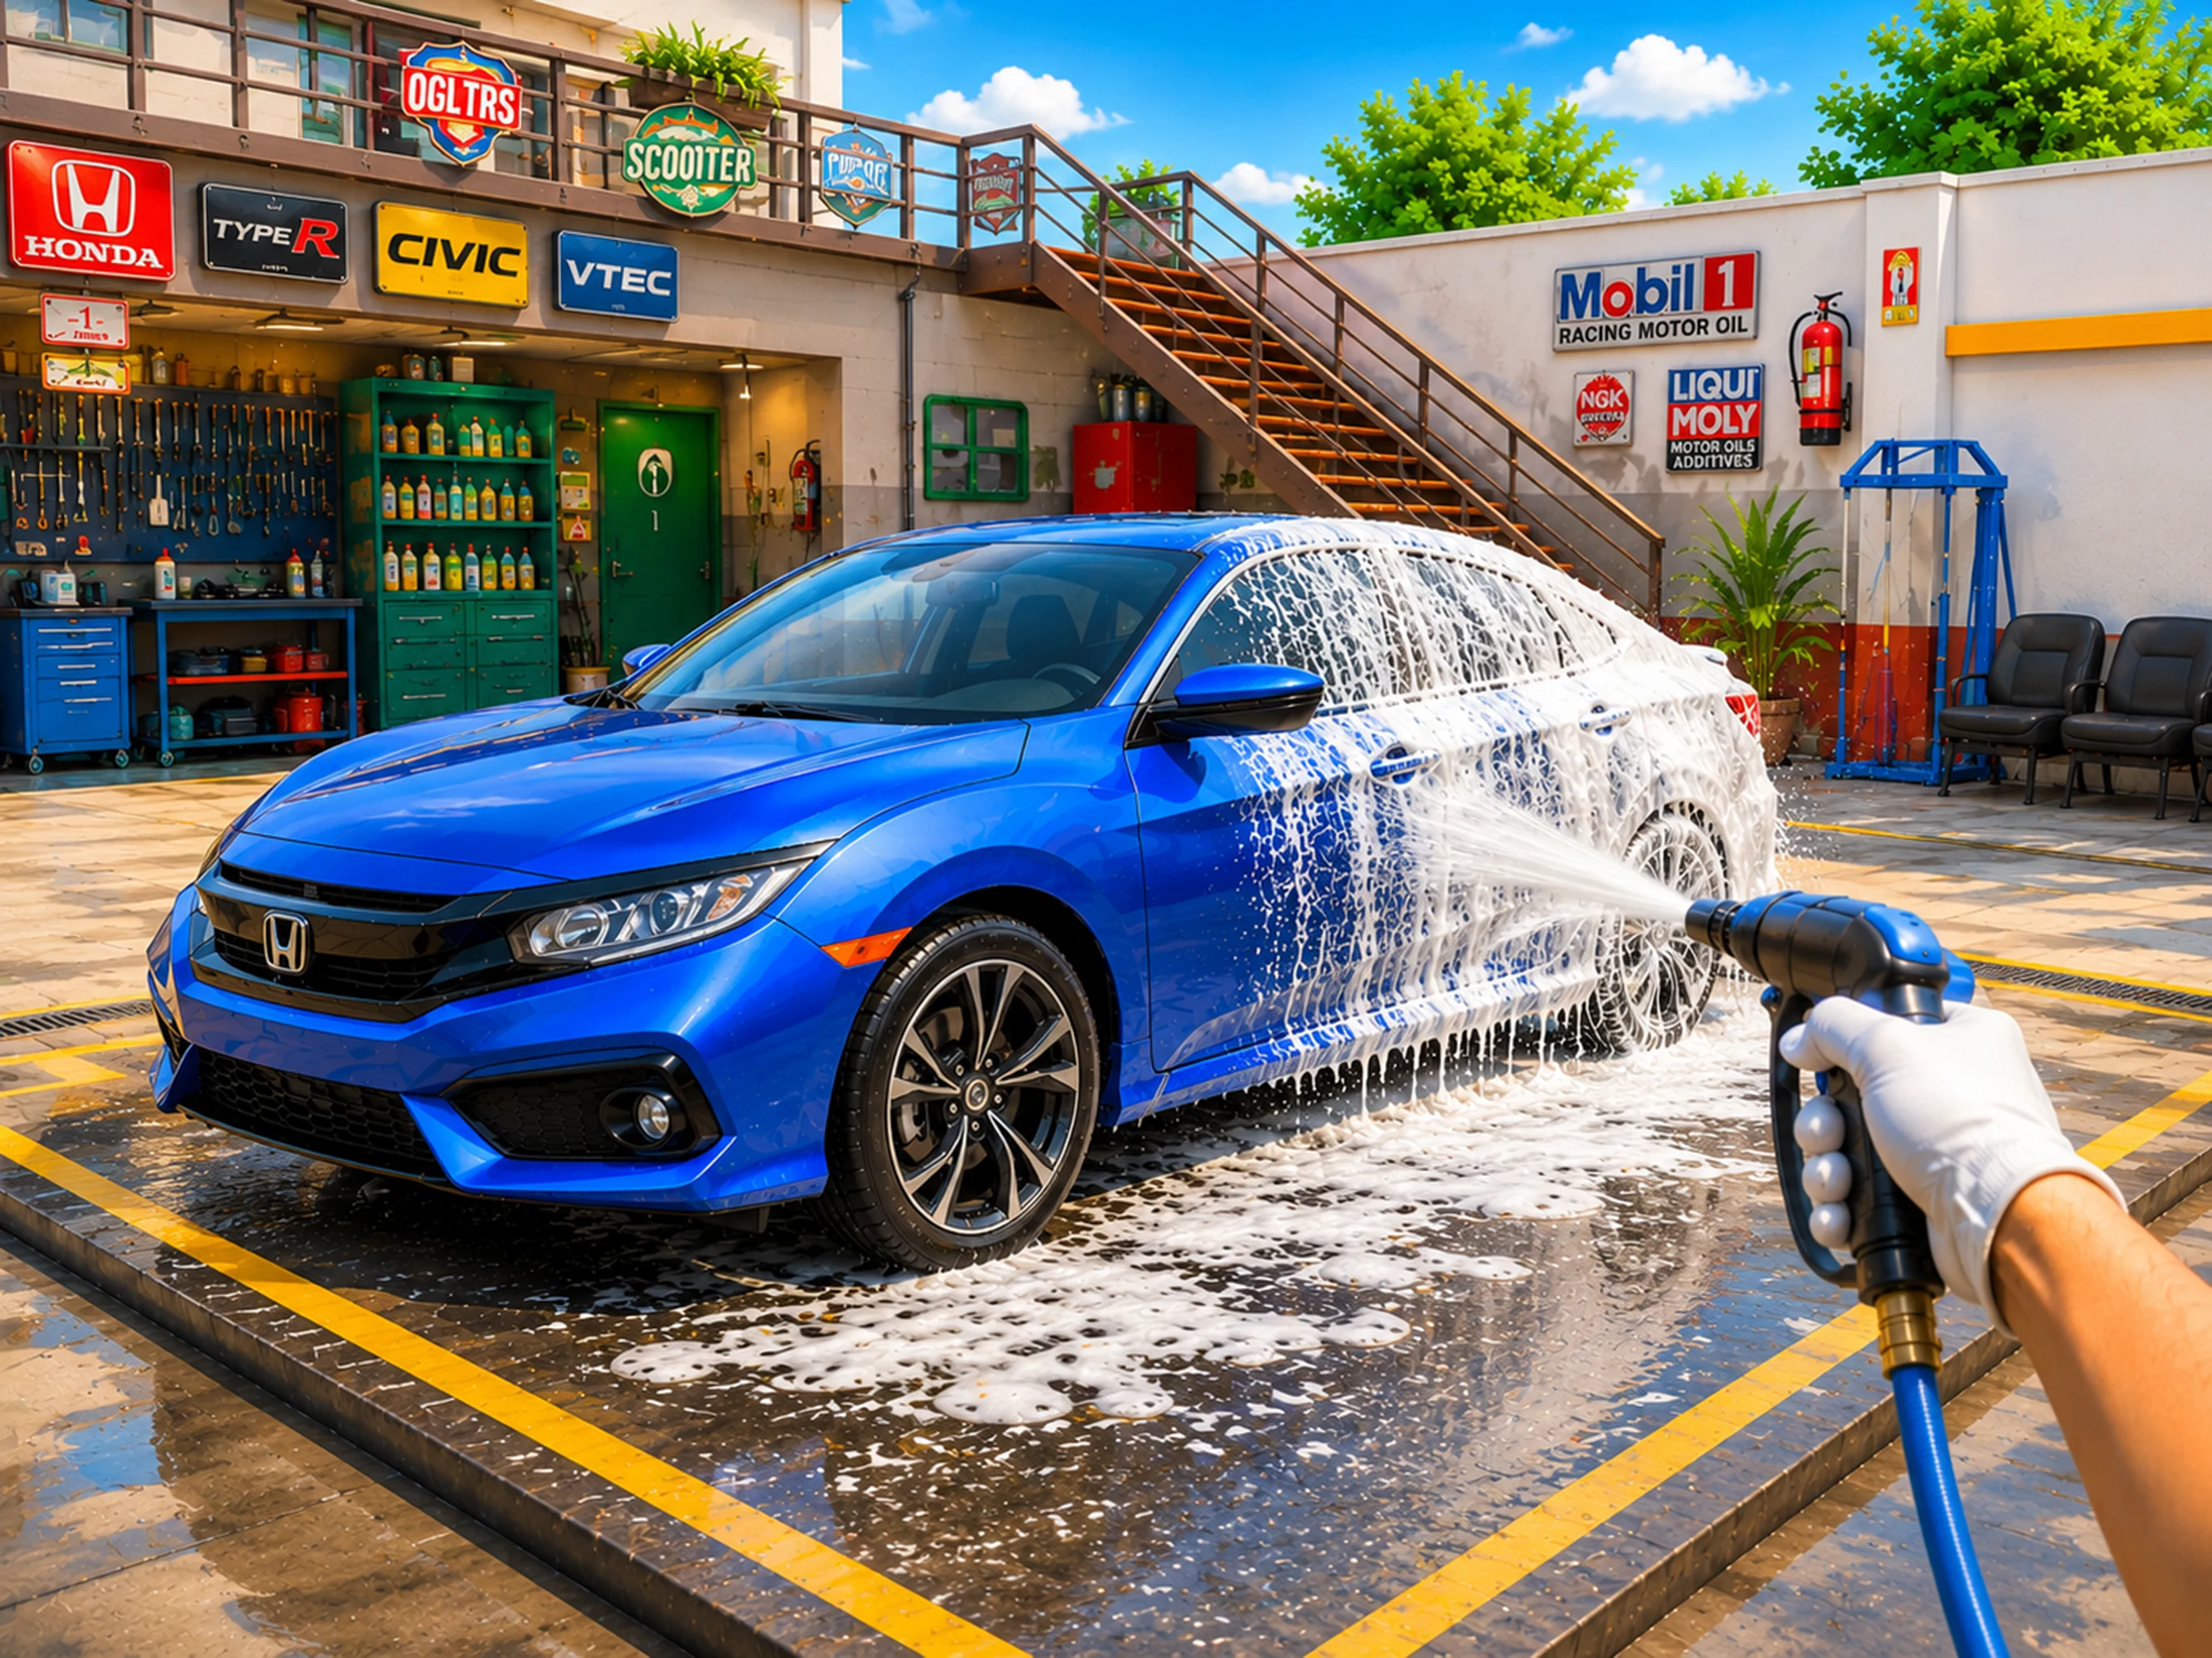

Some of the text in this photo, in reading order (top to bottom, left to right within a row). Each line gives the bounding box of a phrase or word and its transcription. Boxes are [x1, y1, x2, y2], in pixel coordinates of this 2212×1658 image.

[408, 72, 515, 125] OGLTRS
[24, 236, 164, 269] HONDA
[213, 217, 340, 259] TYPE R
[388, 232, 521, 278] CIVIC
[566, 258, 672, 297] VTEC
[1559, 260, 1735, 320] Mobil 1
[1559, 315, 1749, 345] RACING MOTOR OIL
[1580, 389, 1624, 409] NGK
[1674, 368, 1757, 401] LIQUI
[1672, 403, 1758, 436] MOLY
[1670, 439, 1755, 453] MOTOR OILS
